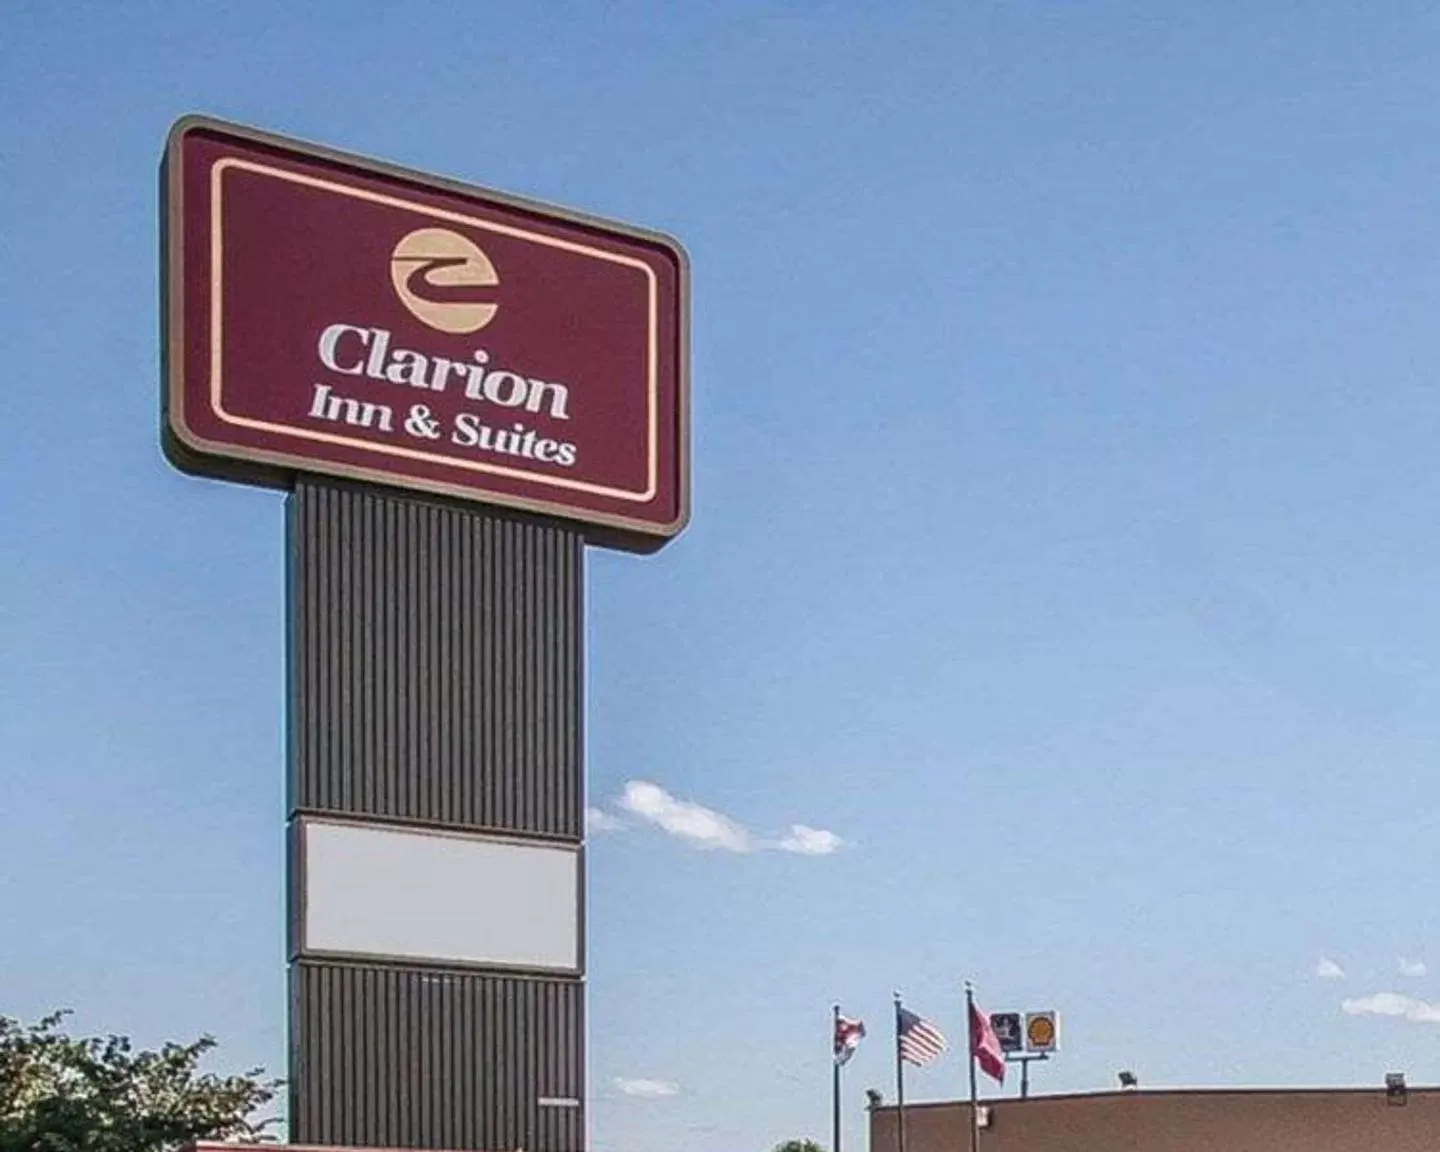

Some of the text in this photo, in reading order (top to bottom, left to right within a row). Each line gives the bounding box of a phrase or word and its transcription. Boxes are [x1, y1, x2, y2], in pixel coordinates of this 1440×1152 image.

[318, 323, 570, 420] Clarion
[308, 384, 578, 466] Inn & Suites
